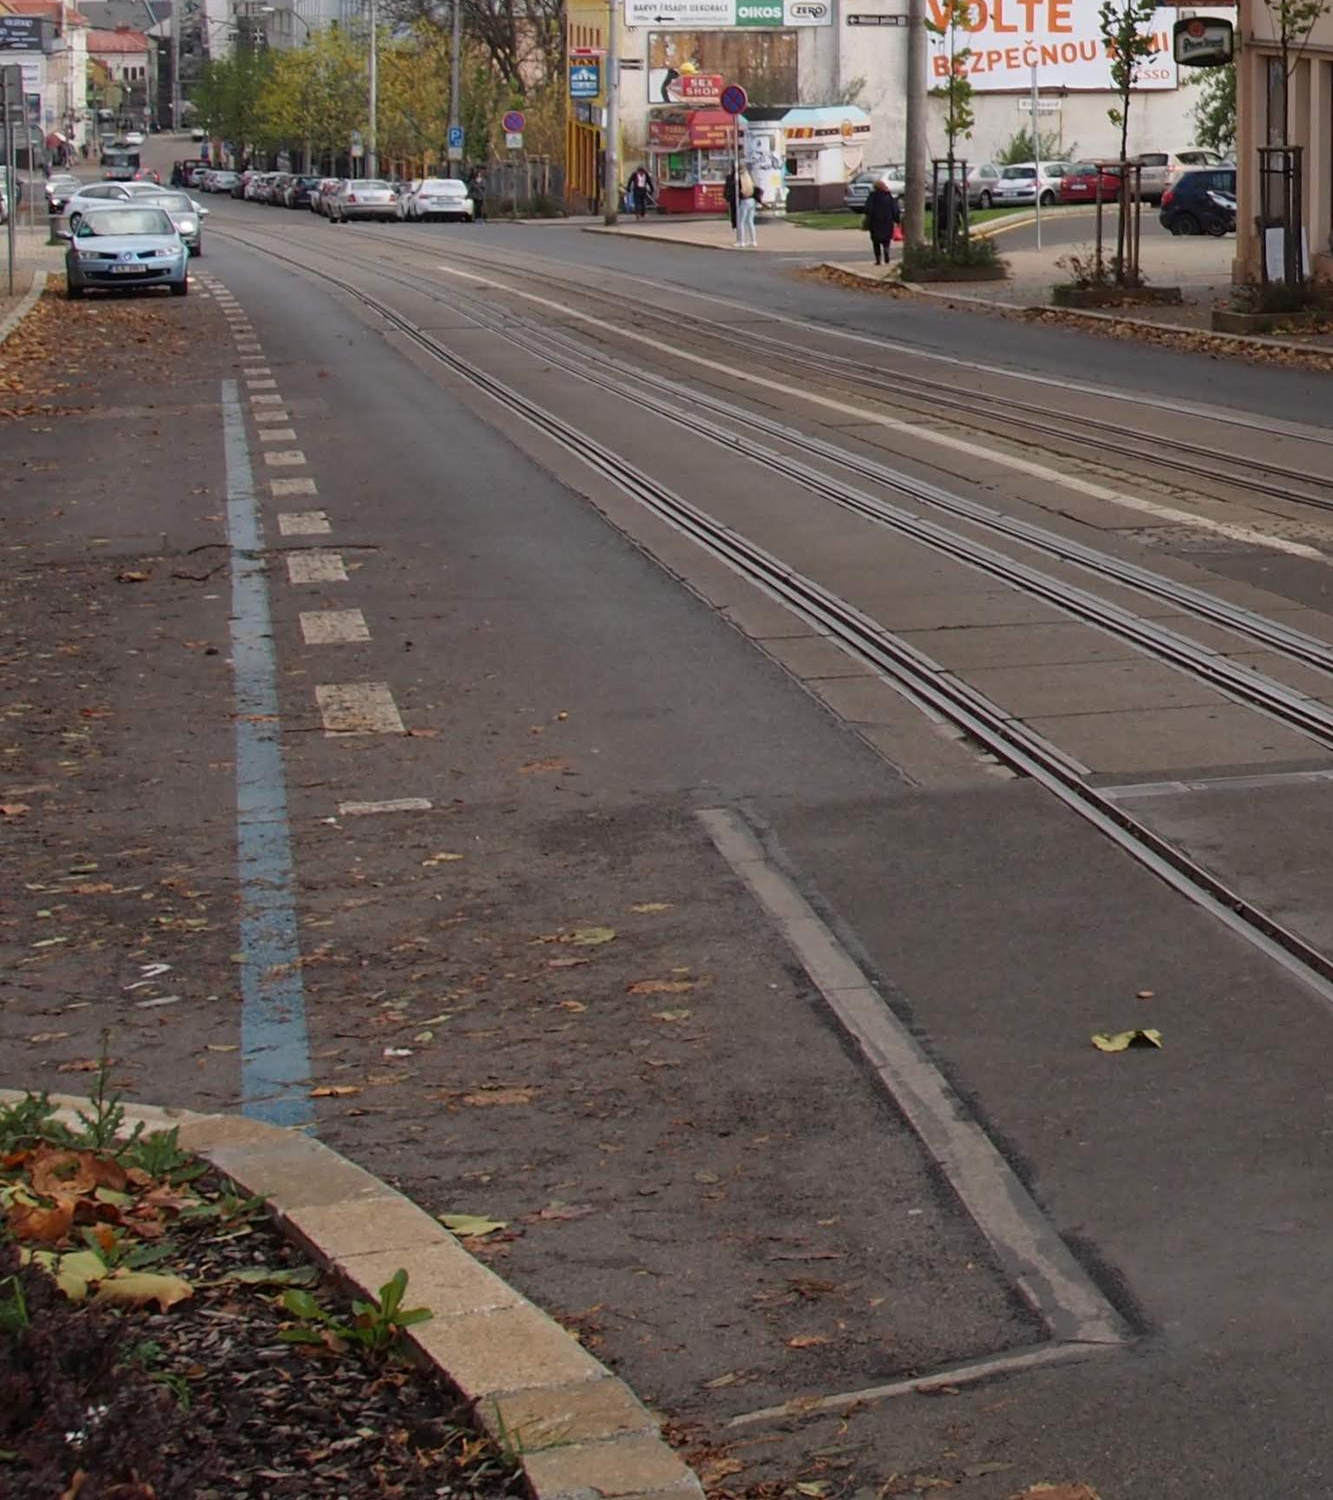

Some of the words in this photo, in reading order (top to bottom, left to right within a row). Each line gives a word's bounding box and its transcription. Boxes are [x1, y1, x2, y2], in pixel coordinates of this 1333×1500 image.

[738, 4, 782, 18] OIKOS
[795, 5, 823, 17] ZERO
[933, 40, 1097, 77] BEZPEČNOU
[688, 78, 714, 87] SEX
[685, 87, 720, 96] SHOP
